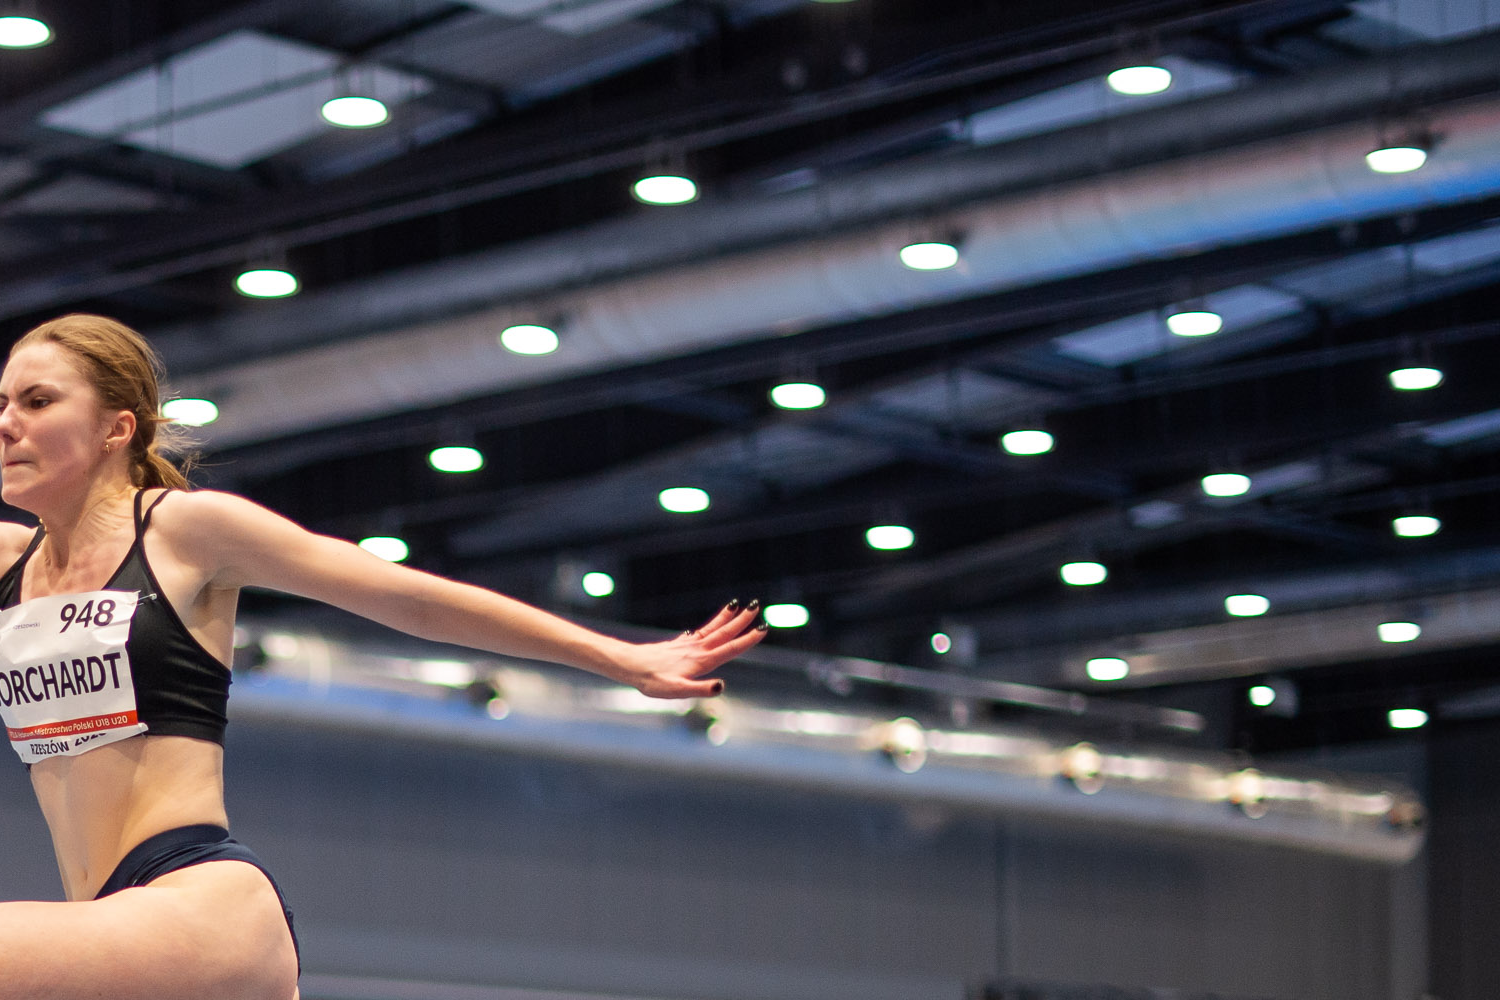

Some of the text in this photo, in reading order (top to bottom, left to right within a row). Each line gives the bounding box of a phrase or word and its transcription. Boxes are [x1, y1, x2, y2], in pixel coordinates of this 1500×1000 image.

[59, 599, 117, 634] 948
[34, 724, 73, 736] Mistrzostwa
[73, 719, 95, 732] Polski
[95, 717, 111, 728] U18
[111, 714, 128, 726] U20
[30, 739, 70, 755] RZESZÓW
